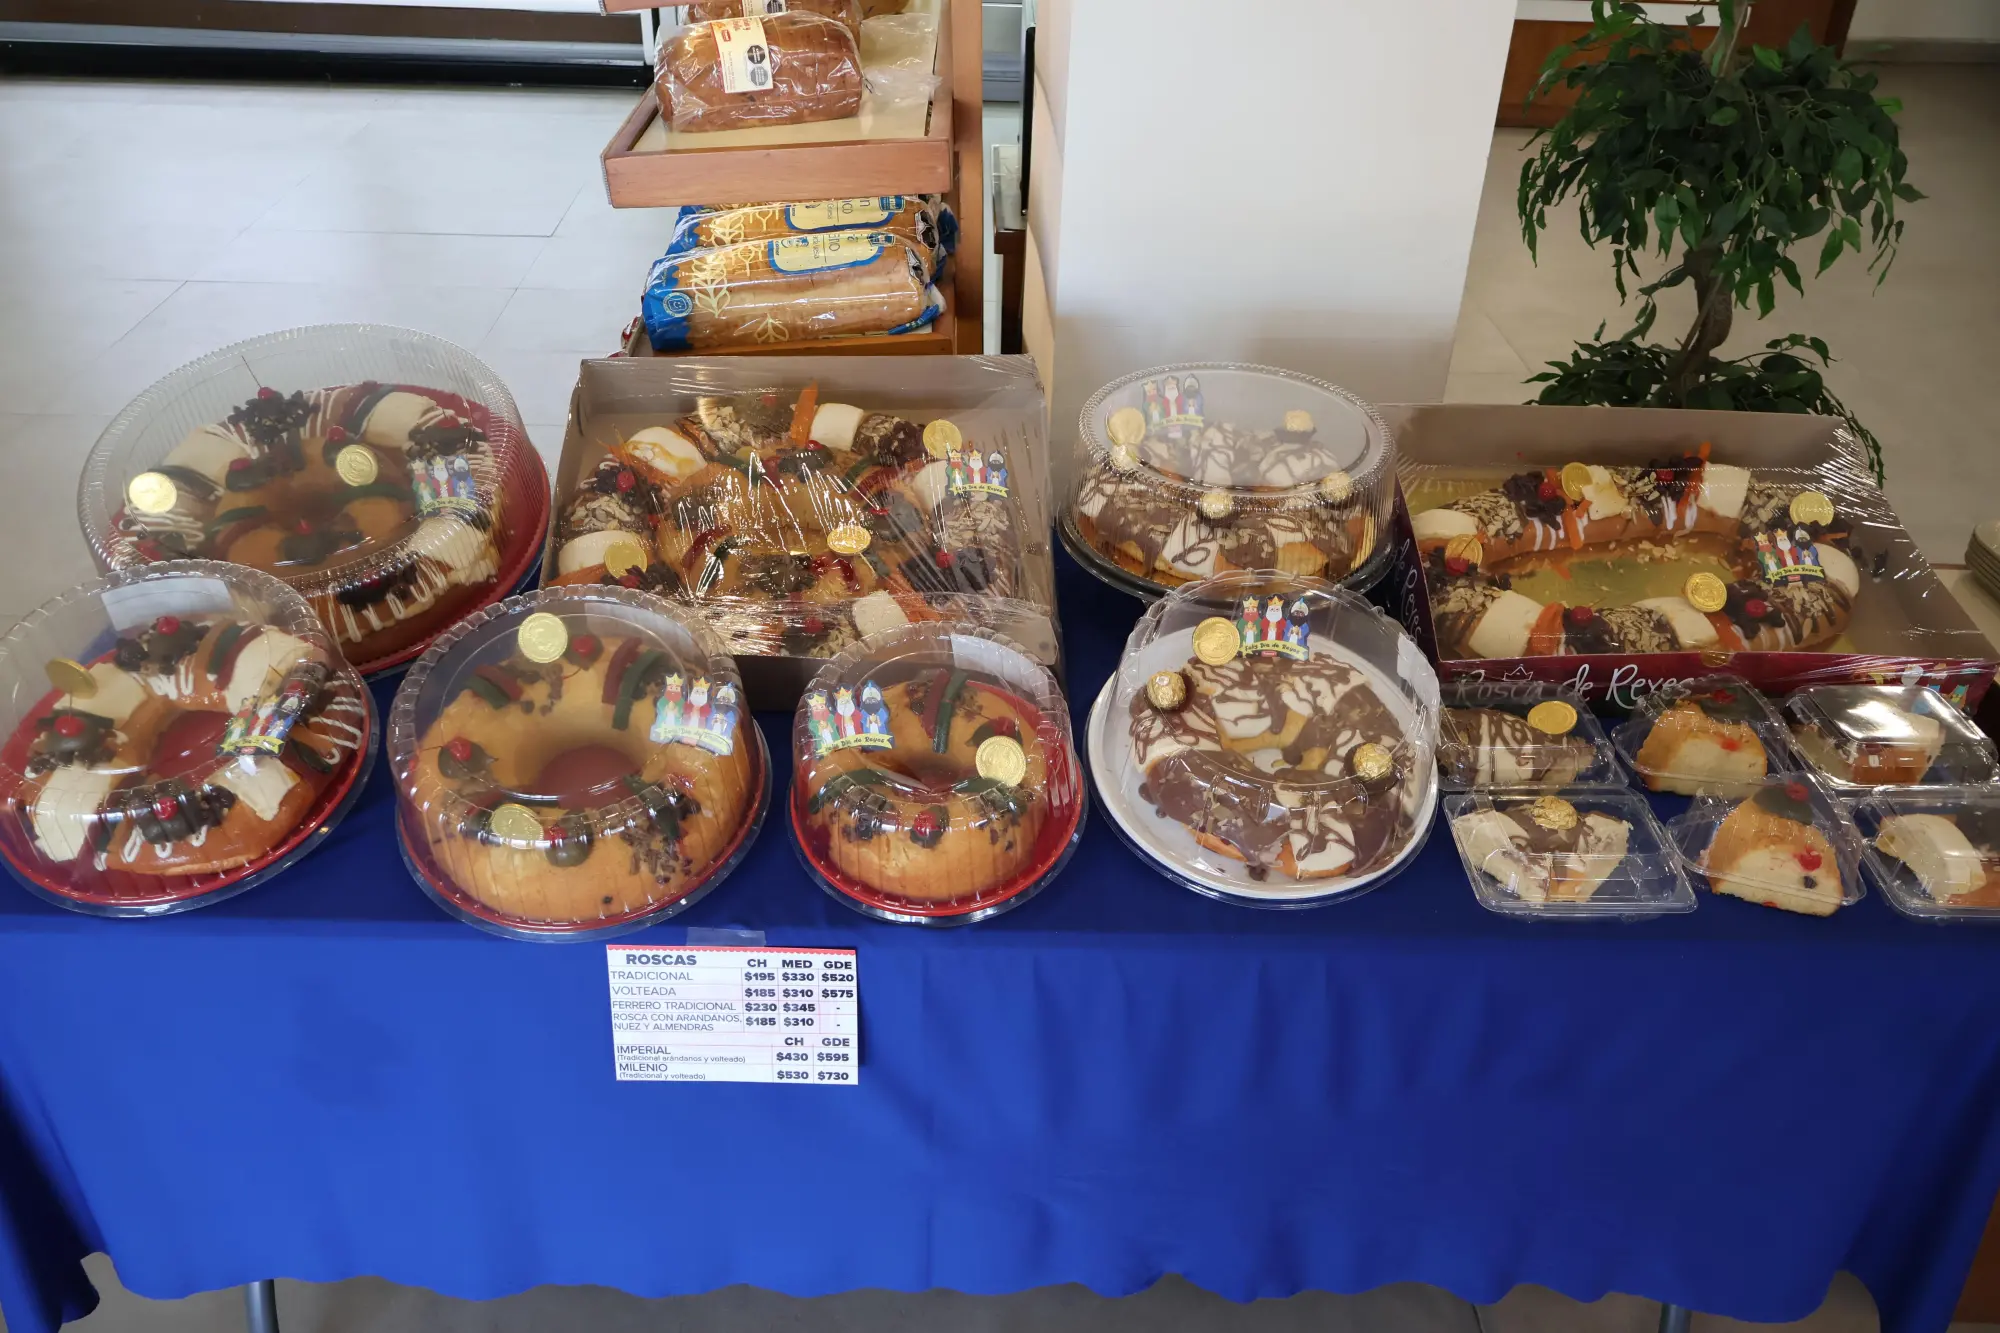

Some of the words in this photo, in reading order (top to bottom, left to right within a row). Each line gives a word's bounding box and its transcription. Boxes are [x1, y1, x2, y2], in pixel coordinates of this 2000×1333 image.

[1282, 644, 1300, 654] Reyes
[1456, 669, 1545, 708] Rosca
[1557, 663, 1593, 702] de
[1605, 664, 1695, 710] Reyes
[626, 954, 697, 966] ROSCAS
[747, 958, 767, 968] CH
[782, 960, 813, 968] MED
[824, 960, 852, 970] GDE
[610, 971, 694, 980] TRADICIONAL
[744, 972, 775, 982] $195
[782, 972, 814, 982] $330
[822, 972, 854, 982] $520
[612, 986, 676, 996] VOLTEADA
[745, 988, 776, 998] $185
[782, 988, 814, 998] $310
[822, 988, 854, 998] $575
[612, 1000, 661, 1010] FERRERO
[664, 1001, 736, 1010] TRADICIONAL
[745, 1002, 777, 1012] $230
[783, 1002, 816, 1012] $345
[614, 1014, 648, 1022] ROSCA
[650, 1014, 674, 1022] CON
[746, 1016, 776, 1026] $185
[784, 1017, 814, 1027] $310
[614, 1022, 640, 1030] NUEZ
[644, 1022, 650, 1030] Y
[653, 1023, 714, 1031] ALMENDRAS
[784, 1037, 804, 1046] CH
[822, 1038, 850, 1046] GDE
[617, 1046, 671, 1054] IMPERIAL
[776, 1052, 808, 1062] $430
[817, 1052, 850, 1062] $595
[617, 1054, 660, 1062] (Tradicional
[619, 1063, 668, 1072] MILENIO
[777, 1070, 809, 1080] $530
[818, 1070, 849, 1080] $730
